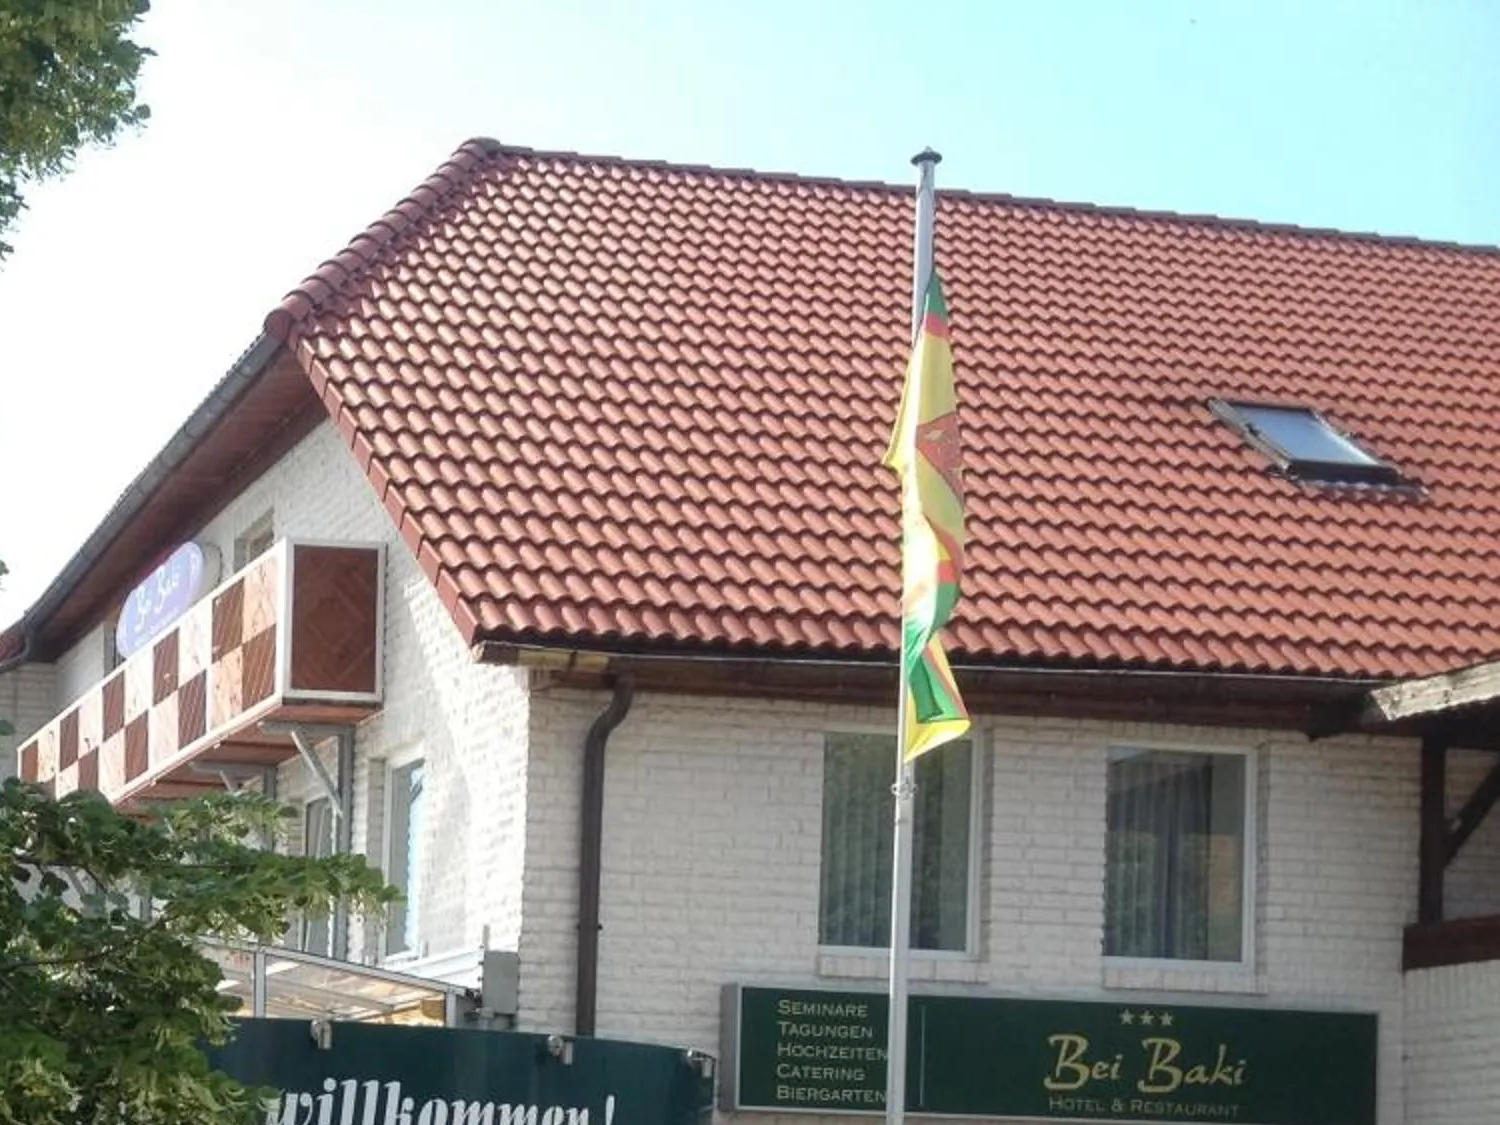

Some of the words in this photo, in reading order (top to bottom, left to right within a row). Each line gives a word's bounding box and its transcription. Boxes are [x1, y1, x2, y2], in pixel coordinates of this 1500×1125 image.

[777, 999, 868, 1018] SEMINARE
[777, 1021, 873, 1039] TAGUNGEN
[777, 1042, 889, 1061] HOCHZEITEN
[776, 1063, 866, 1081] CATERING
[1043, 1033, 1124, 1090] Bei
[1137, 1037, 1247, 1093] Baki
[776, 1085, 887, 1103] BIERGARTEN
[1049, 1096, 1105, 1112] HOTEL
[1111, 1098, 1124, 1113] &
[1130, 1098, 1239, 1118] RESTAURANT
